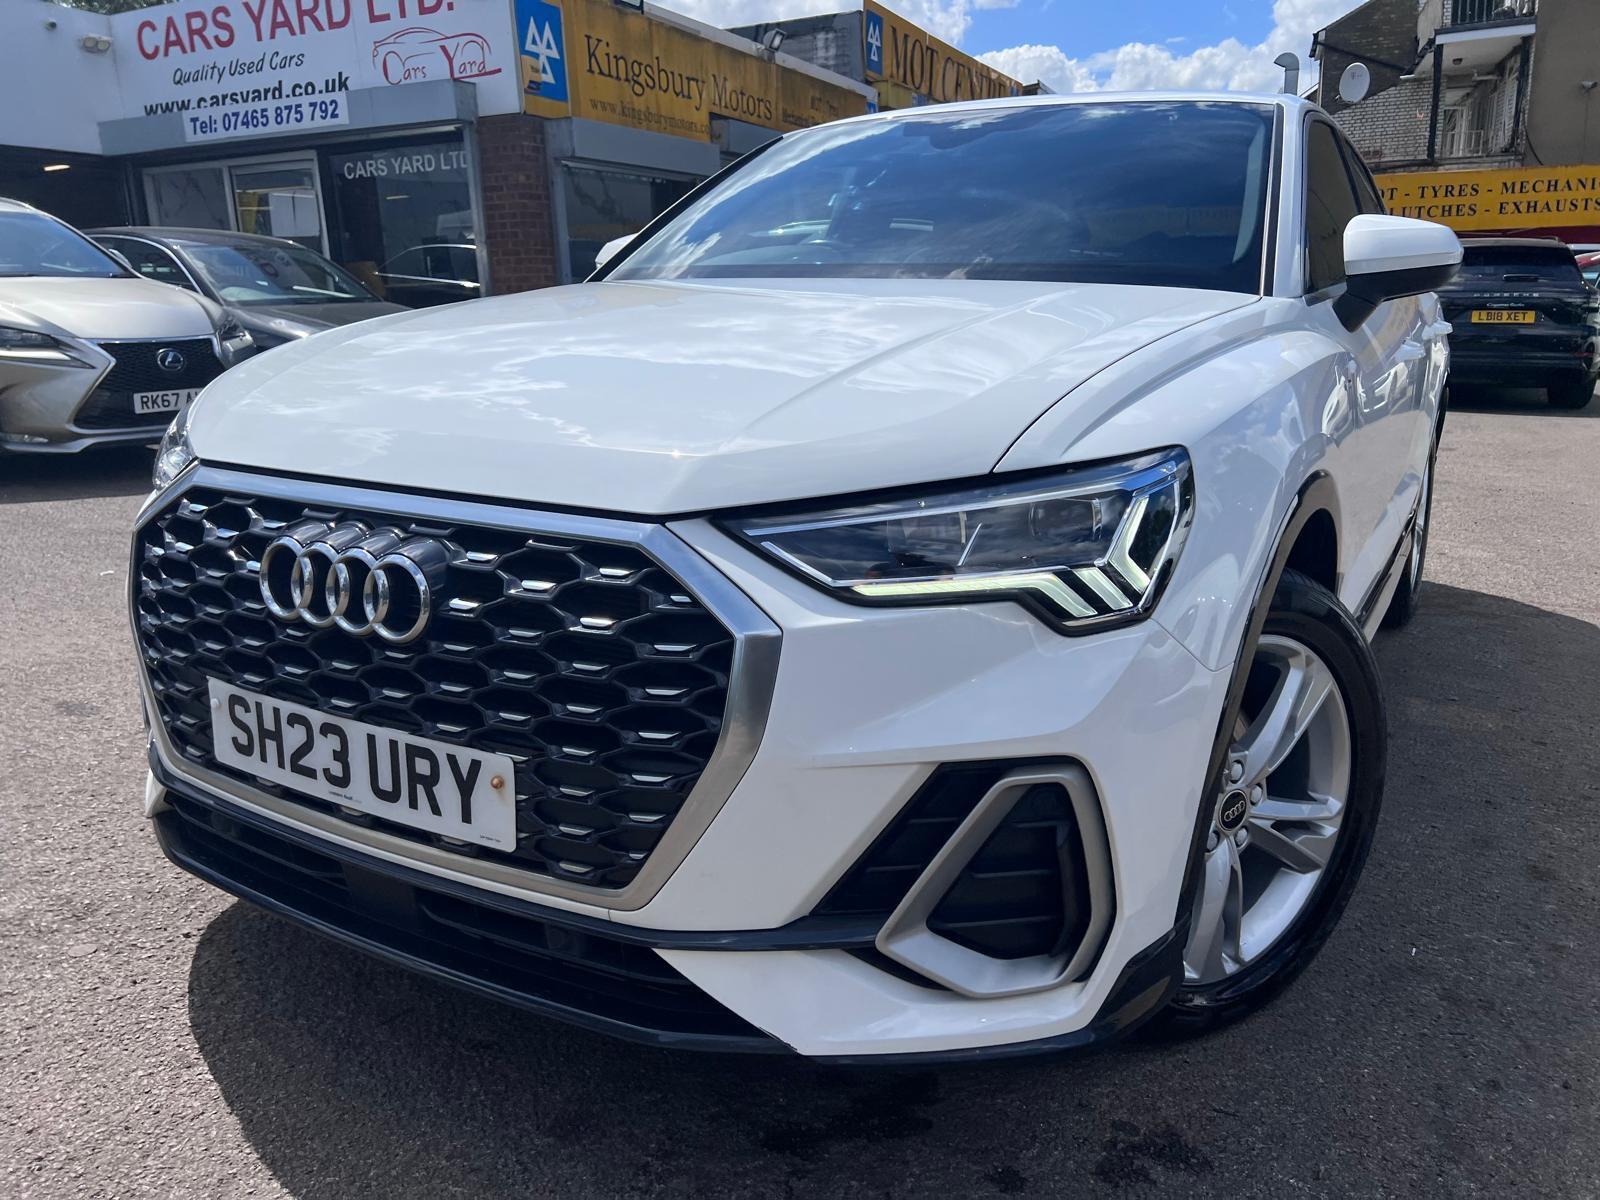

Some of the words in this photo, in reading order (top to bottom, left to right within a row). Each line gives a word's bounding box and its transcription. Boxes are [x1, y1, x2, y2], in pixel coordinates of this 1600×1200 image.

[137, 5, 235, 61] CARS
[242, 0, 351, 42] YARD
[172, 61, 226, 86] Quality
[228, 52, 267, 77] Used
[269, 51, 305, 71] Cars
[382, 50, 428, 86] Cars
[440, 41, 490, 81] Yard
[584, 34, 706, 111] Kingsbury
[712, 74, 773, 121] Motors
[890, 25, 938, 97] MOT
[189, 115, 218, 136] Tel:
[222, 108, 269, 132] 07465
[274, 103, 304, 126] 875
[308, 99, 340, 122] 792
[343, 159, 388, 180] CARS
[391, 154, 436, 175] YARD
[1417, 183, 1480, 199] TYRES
[1500, 176, 1600, 195] MECHANI
[1388, 203, 1478, 219] LUTCHES
[1498, 197, 1600, 215] EXHAUSTS
[1506, 311, 1528, 321] XET
[140, 392, 180, 411] RK67
[228, 693, 351, 789] SH23
[366, 732, 482, 825] URY
